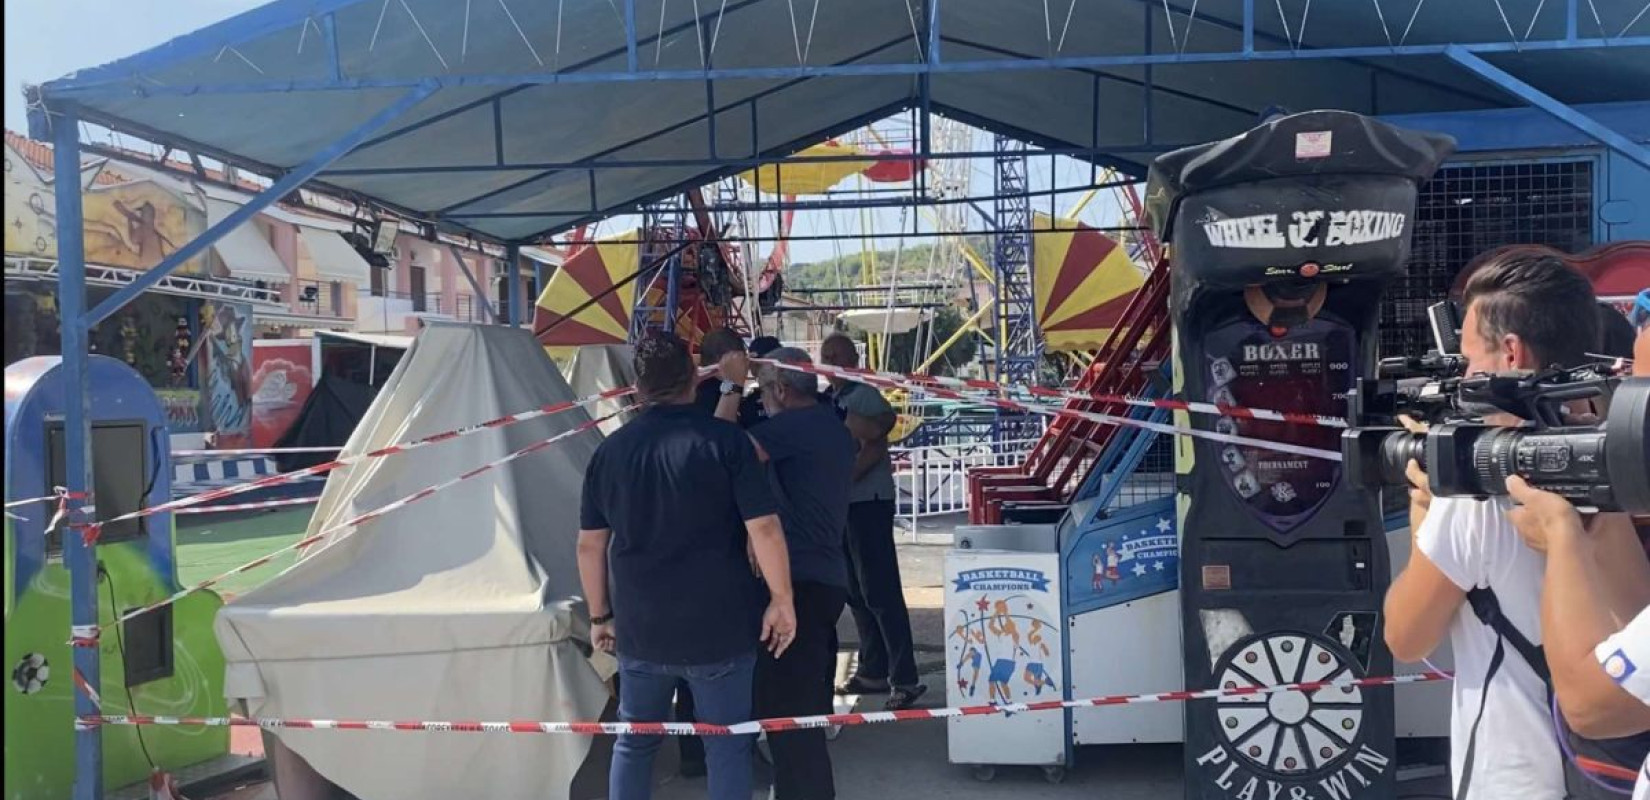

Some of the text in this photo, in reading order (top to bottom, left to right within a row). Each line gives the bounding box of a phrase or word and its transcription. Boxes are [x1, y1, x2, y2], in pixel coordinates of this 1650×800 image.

[1203, 214, 1286, 248] WHEEL
[1325, 210, 1406, 247] BOXING
[1243, 343, 1320, 361] BOXER
[1329, 362, 1349, 370] 900
[1257, 460, 1309, 470] TOURNAMENT
[960, 569, 1040, 582] BASKETBALL
[972, 582, 1029, 591] CHAMPIONS
